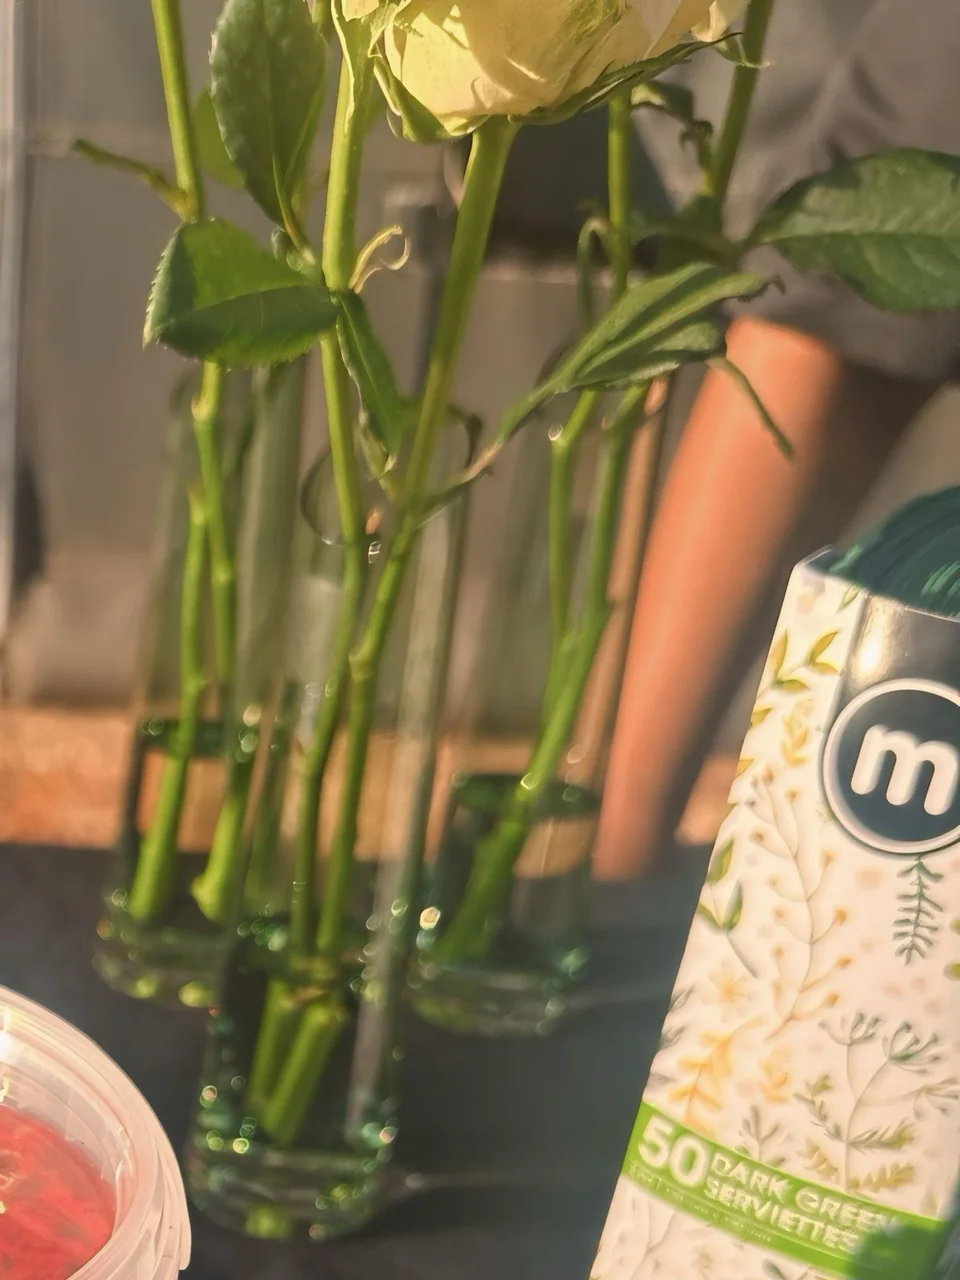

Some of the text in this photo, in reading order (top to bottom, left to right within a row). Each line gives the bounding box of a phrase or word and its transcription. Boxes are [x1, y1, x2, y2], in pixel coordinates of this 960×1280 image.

[638, 1114, 710, 1188] 50
[711, 1154, 790, 1203] DARK
[704, 1177, 861, 1254] SERVIETTES
